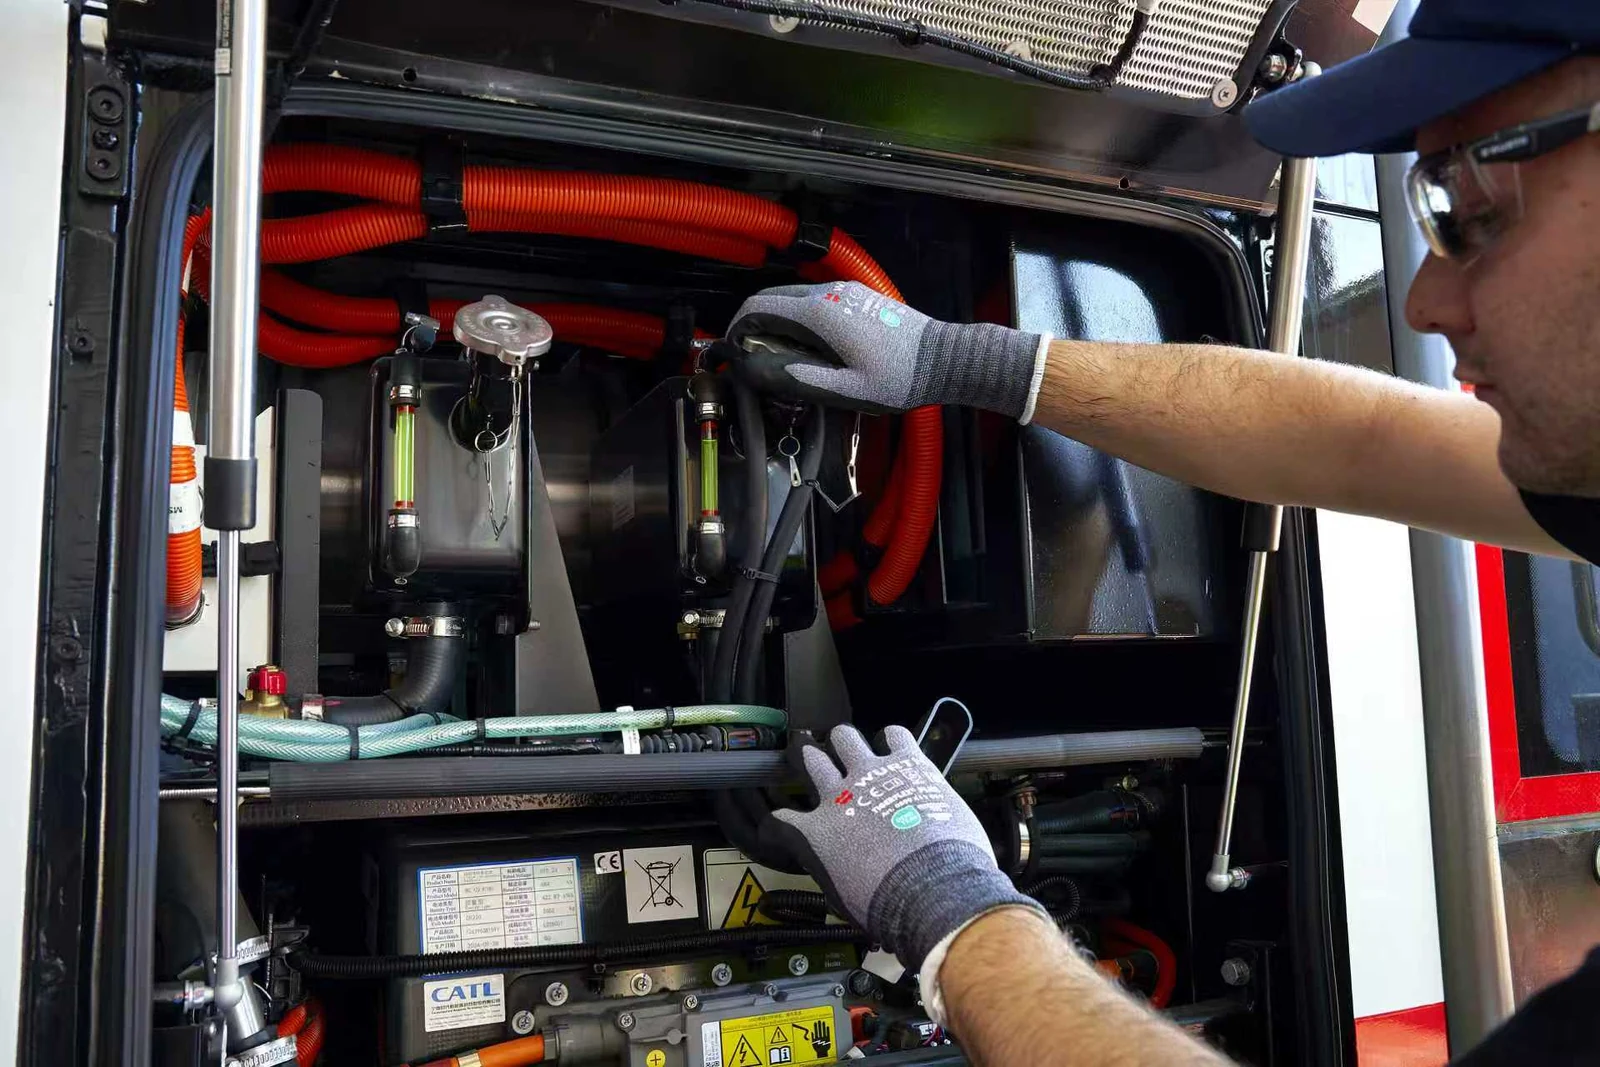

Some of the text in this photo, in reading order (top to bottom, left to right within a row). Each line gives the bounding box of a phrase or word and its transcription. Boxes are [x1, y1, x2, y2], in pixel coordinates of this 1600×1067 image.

[845, 808, 855, 816] 9
[597, 854, 619, 870] CE
[432, 982, 500, 1003] CATL
